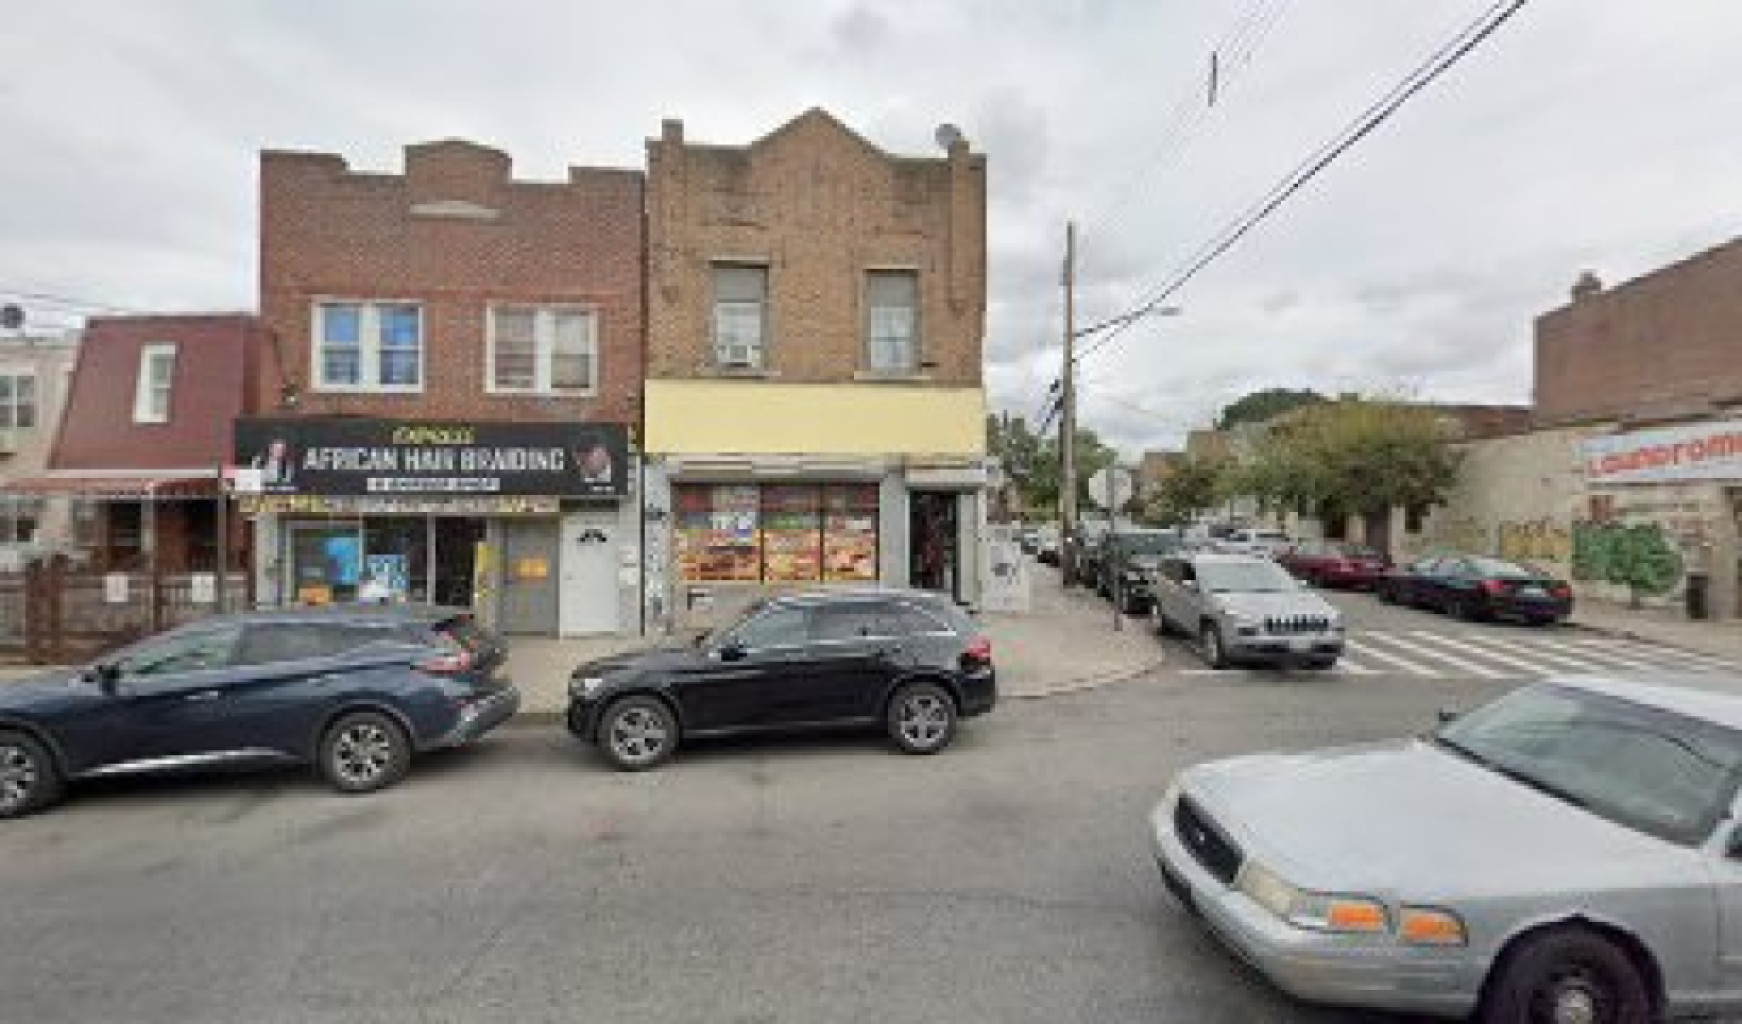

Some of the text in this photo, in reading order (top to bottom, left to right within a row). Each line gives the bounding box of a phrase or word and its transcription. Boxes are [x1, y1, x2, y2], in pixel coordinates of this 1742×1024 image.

[302, 447, 564, 470] AFRICAN HAIR BRAIDING
